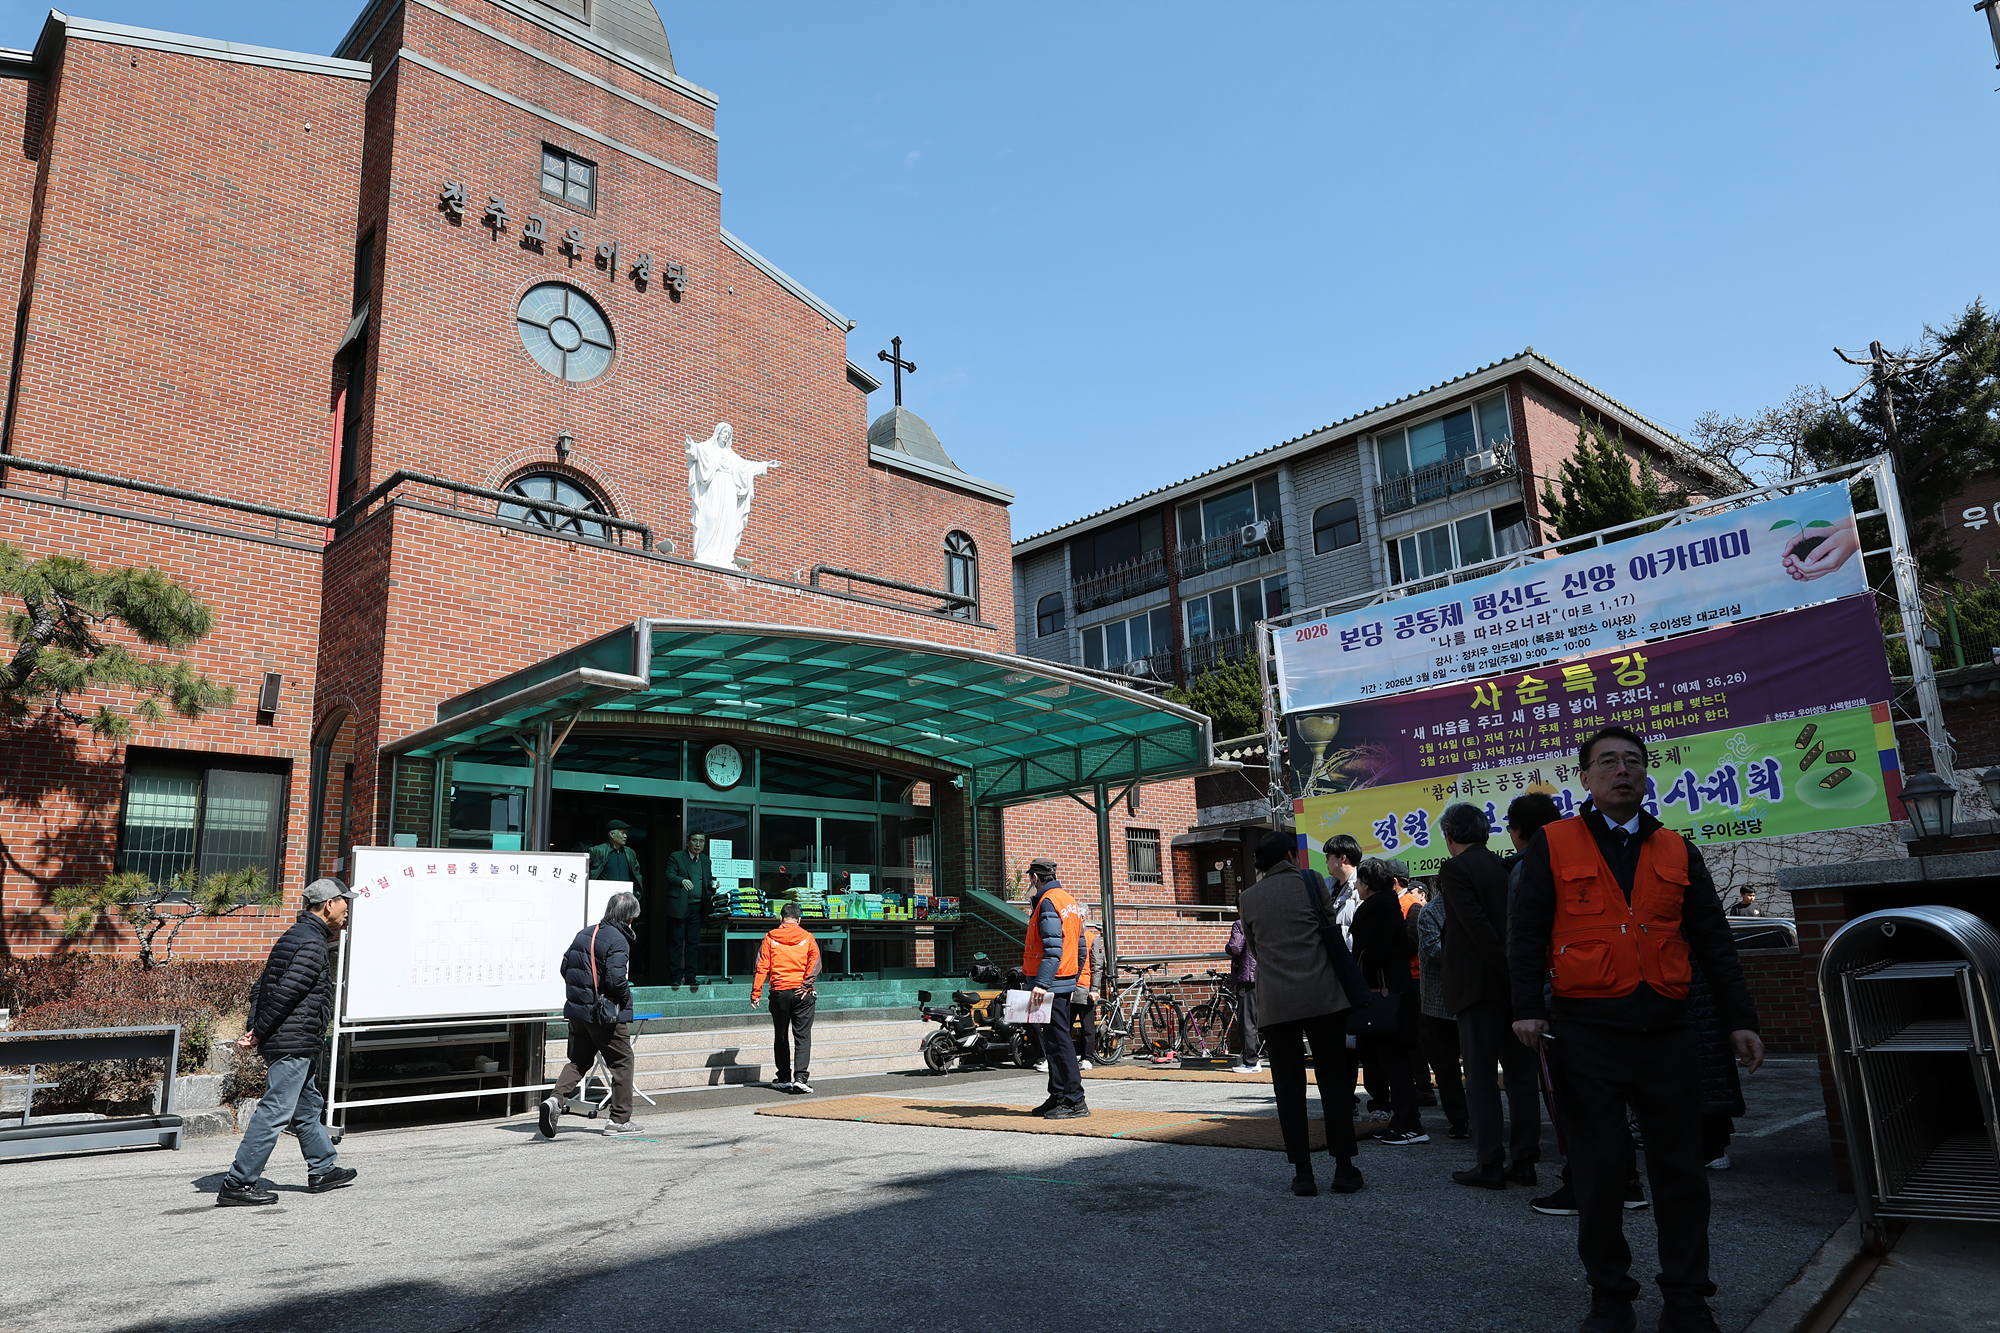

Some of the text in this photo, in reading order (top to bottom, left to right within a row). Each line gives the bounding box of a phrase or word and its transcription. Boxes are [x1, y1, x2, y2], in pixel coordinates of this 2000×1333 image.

[1962, 502, 2000, 531] 우
[1340, 528, 1752, 653] 본당 공동체 평신도 신앙 아카데미
[1295, 623, 1328, 642] 2026
[1360, 684, 1377, 695] 기간
[1385, 676, 1413, 690] 2026년
[1416, 671, 1430, 683] 3월
[1432, 668, 1447, 681] 8일
[1461, 661, 1476, 674] 6월
[1478, 651, 1523, 671] 21일(주일)
[1525, 647, 1548, 660] 9:00
[1563, 638, 1592, 652] 10:00
[1616, 626, 1639, 642] 장소
[1648, 614, 1693, 634] 우이성당
[1696, 603, 1743, 623] 대교리실
[1435, 654, 1453, 667] 강사
[1462, 646, 1489, 662] 정치우
[1491, 638, 1529, 655] 안드레아
[1532, 629, 1566, 647] (복음화
[1567, 621, 1599, 638] 발전소
[1601, 612, 1637, 630] 이사장)
[1413, 726, 1426, 740] 새
[1431, 718, 1471, 737] 마음을
[1477, 713, 1505, 730] 주고
[1511, 708, 1526, 724] 새
[1532, 702, 1561, 720] 영을
[1568, 696, 1598, 714] 넣어
[1672, 679, 1701, 696] (에제
[1706, 670, 1748, 689] 36,26)
[1418, 742, 1435, 754] 3월
[1437, 738, 1459, 751] 14일
[1462, 735, 1480, 748] (토)
[1484, 731, 1504, 743] 저녁
[1507, 727, 1524, 740] 7시
[1537, 722, 1560, 736] 주제
[1572, 714, 1606, 730] 회개는
[1610, 706, 1645, 723] 사랑의
[1648, 699, 1685, 717] 열매를
[1689, 692, 1728, 709] 맺는다
[1773, 710, 1797, 721] 천주교
[1420, 756, 1436, 767] 3월
[1439, 753, 1460, 765] 21일
[1463, 749, 1482, 761] (토)
[1485, 745, 1506, 757] 저녁
[1508, 741, 1526, 754] 7시
[1539, 737, 1562, 750] 주제
[1651, 713, 1701, 731] 태어나야
[1704, 707, 1730, 723] 한다
[1471, 760, 1490, 772] 강사
[1498, 755, 1525, 768] 정치우
[1422, 777, 1491, 802] "참여하는
[1494, 768, 1550, 793] 공동체,
[1373, 809, 1429, 850] 정월
[1700, 817, 1763, 841] 우이성당
